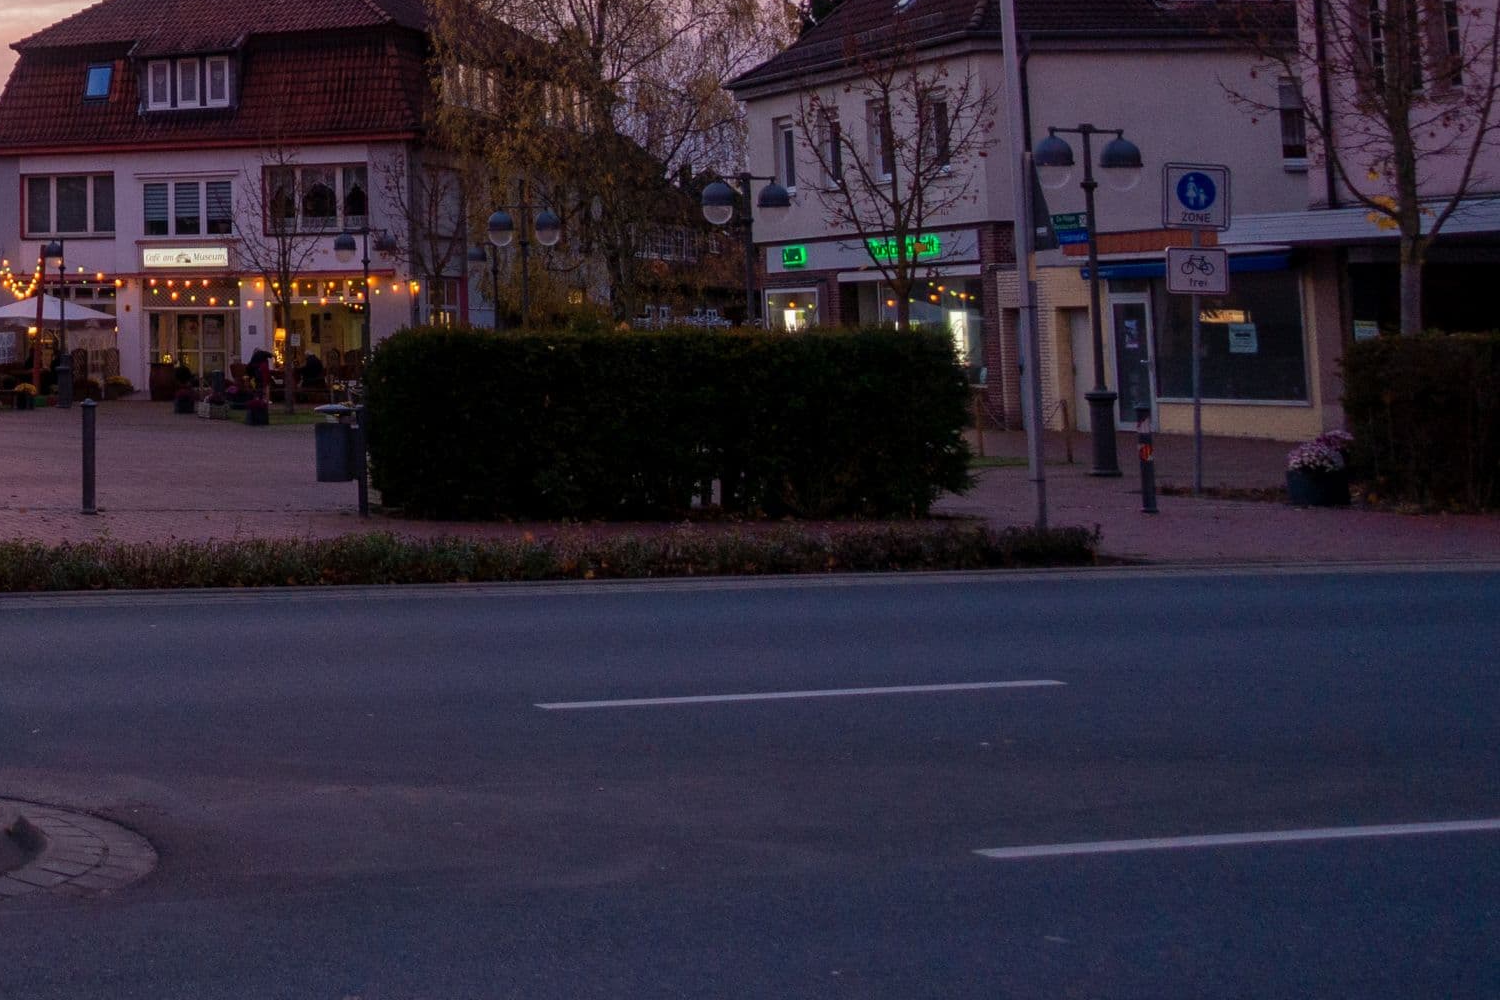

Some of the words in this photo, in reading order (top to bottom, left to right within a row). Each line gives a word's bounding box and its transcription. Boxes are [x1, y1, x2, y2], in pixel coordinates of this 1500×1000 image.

[1181, 212, 1212, 223] ZONE
[193, 252, 227, 262] Museum
[1189, 278, 1208, 288] frei
